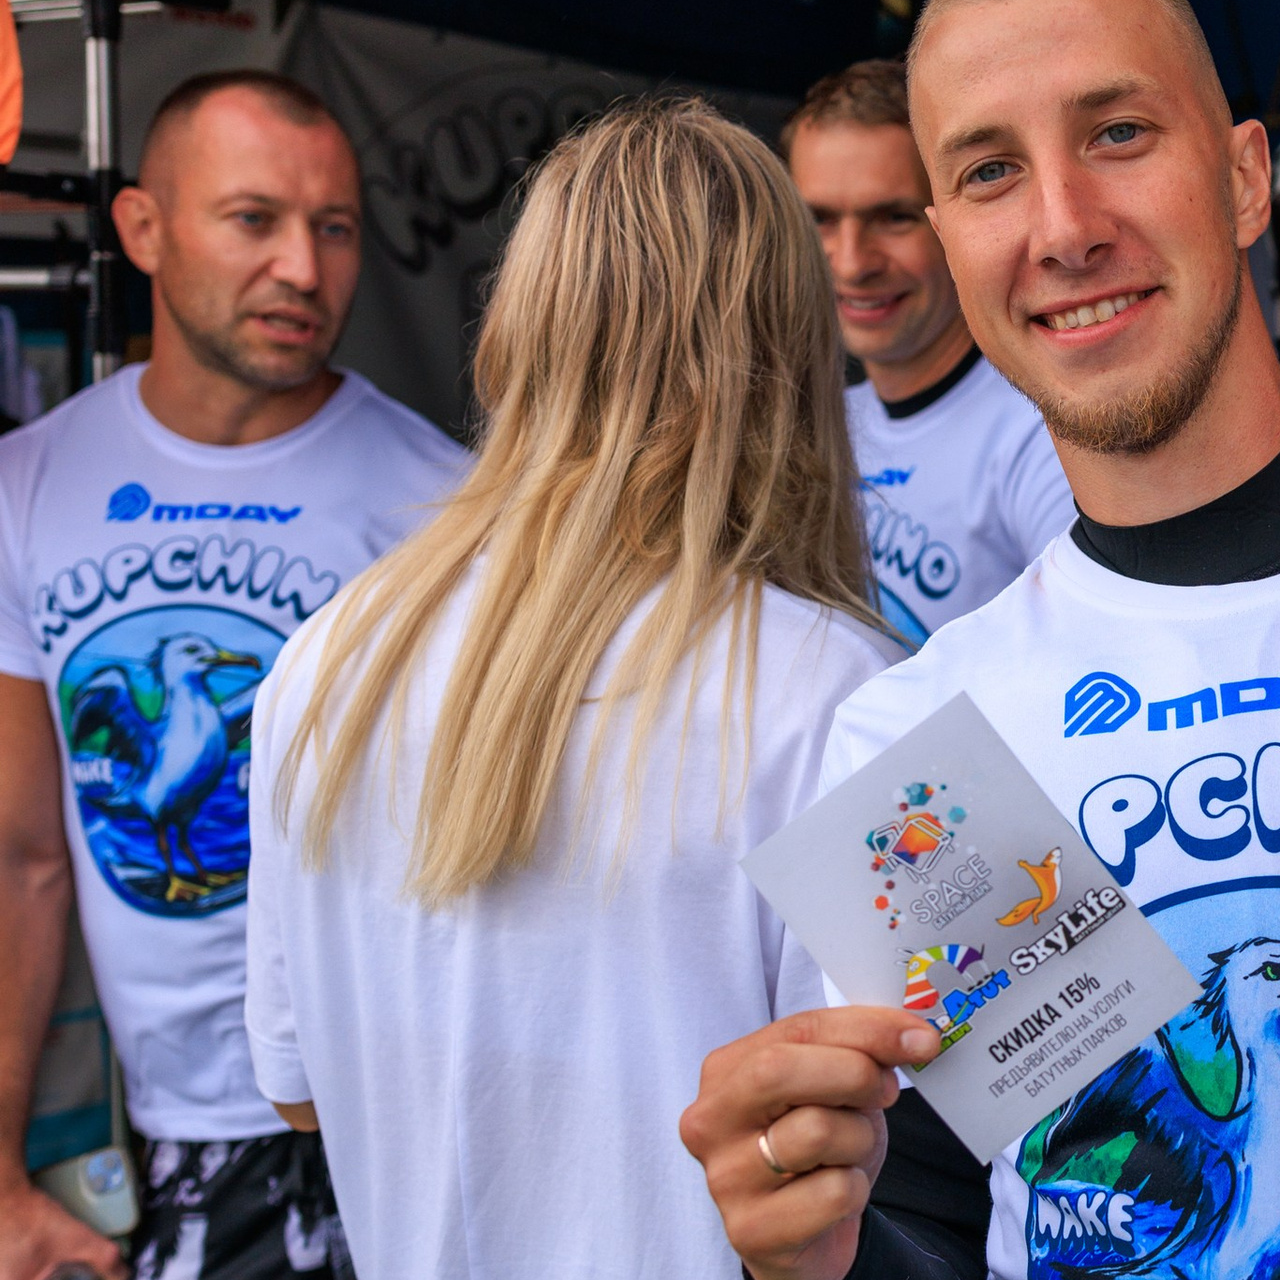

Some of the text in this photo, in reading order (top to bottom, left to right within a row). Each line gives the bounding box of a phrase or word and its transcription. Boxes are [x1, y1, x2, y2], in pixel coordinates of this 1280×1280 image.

[152, 501, 304, 524] MDAY
[32, 533, 342, 654] KUPCHIN
[909, 852, 993, 925] SPACE
[1008, 885, 1122, 977] SkyLife
[987, 1024, 1077, 1100] ПРЕДЪЯВИТЕЛЮ
[1072, 1015, 1094, 1041] НА
[1090, 979, 1136, 1023] УСЛУГИ
[988, 1002, 1063, 1065] СКИДКА
[1057, 972, 1101, 1010] 15%
[1023, 1012, 1128, 1099] БАТУТНЫХ ПАРКОВ
